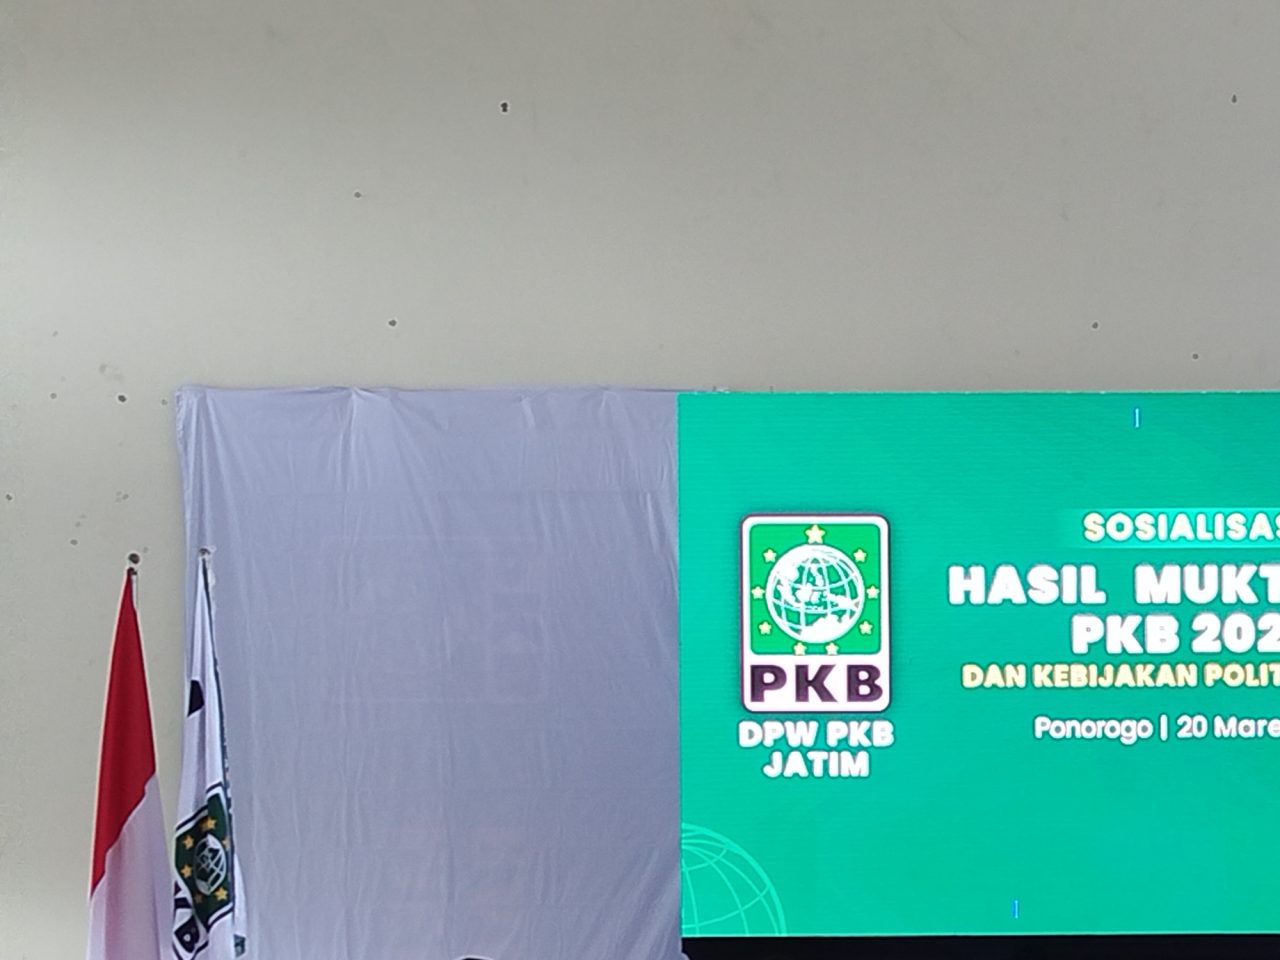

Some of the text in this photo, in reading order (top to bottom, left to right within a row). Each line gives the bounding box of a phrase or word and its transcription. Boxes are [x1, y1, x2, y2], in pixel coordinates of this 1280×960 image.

[948, 564, 1106, 605] HASIL
[1071, 613, 1181, 655] PKB
[749, 664, 884, 704] PKB
[961, 663, 1027, 689] DAN
[1032, 663, 1198, 689] KEBIJAKAN
[738, 720, 896, 749] DPW PKB
[1034, 715, 1153, 745] Ponorogo
[1176, 714, 1208, 739] 20
[763, 751, 871, 778] JATIM
